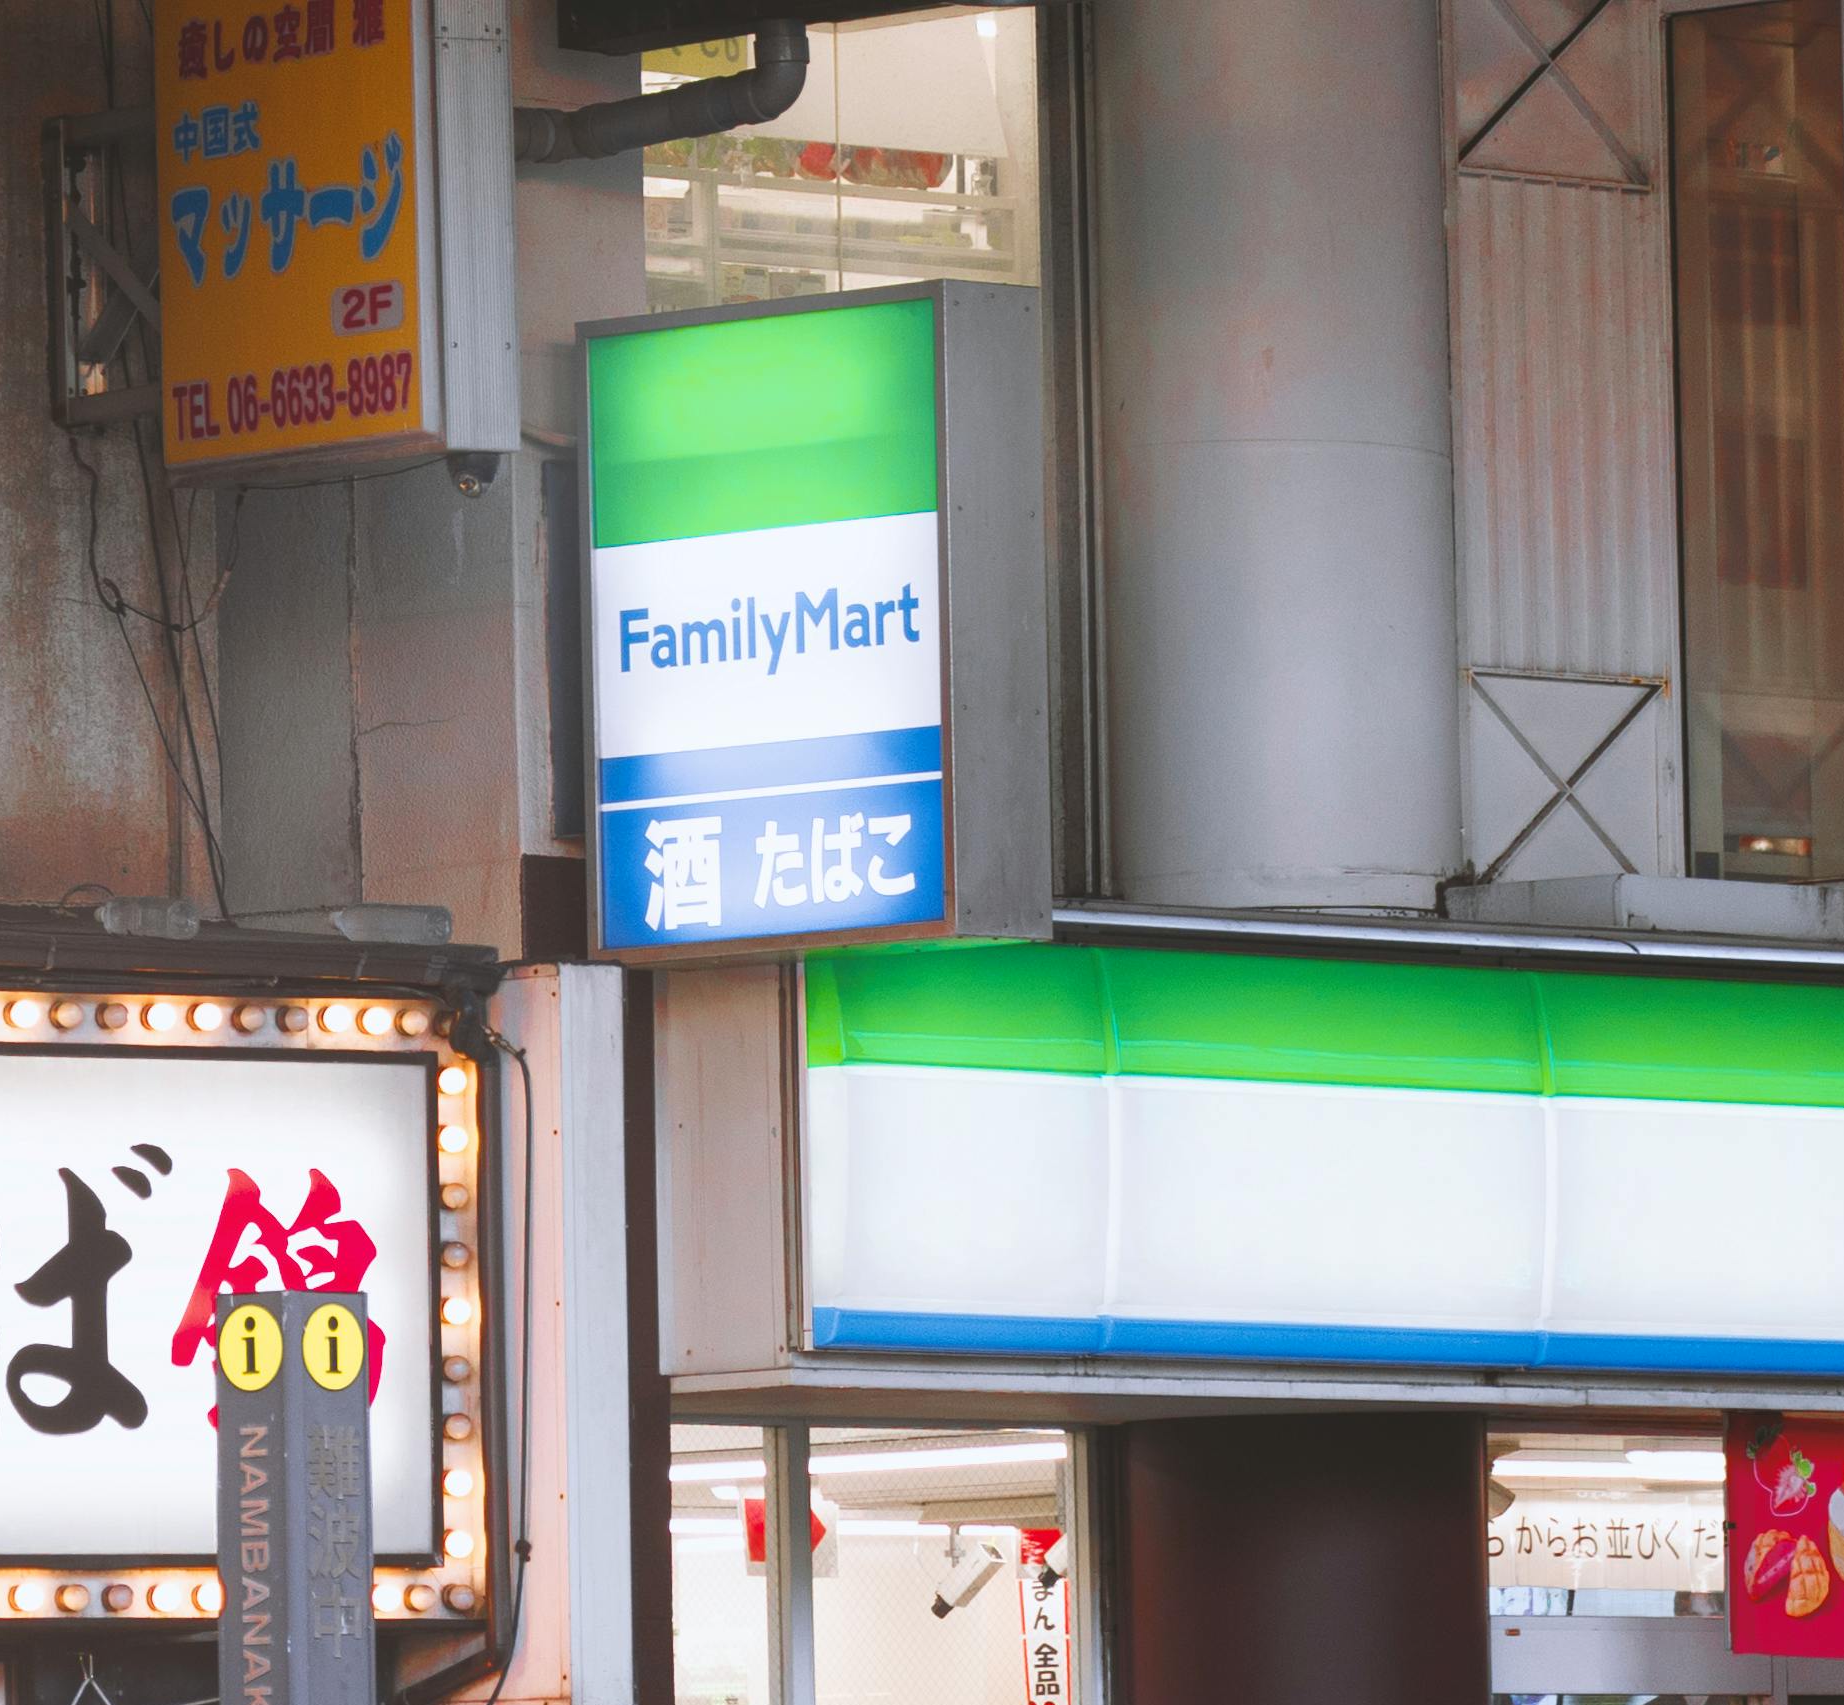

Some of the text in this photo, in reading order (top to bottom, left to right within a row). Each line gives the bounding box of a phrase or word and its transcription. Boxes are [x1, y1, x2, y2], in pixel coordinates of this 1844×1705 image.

[173, 101, 262, 164] 中国式
[170, 133, 404, 287] マッサージ
[341, 289, 394, 328] 2F
[172, 352, 413, 442] TEL 06-6633-8987
[618, 583, 921, 675] FamilyMart
[645, 813, 917, 929] 酒 たばこ
[307, 1424, 363, 1659] 難波中
[1034, 1643, 1060, 1696] 全品
